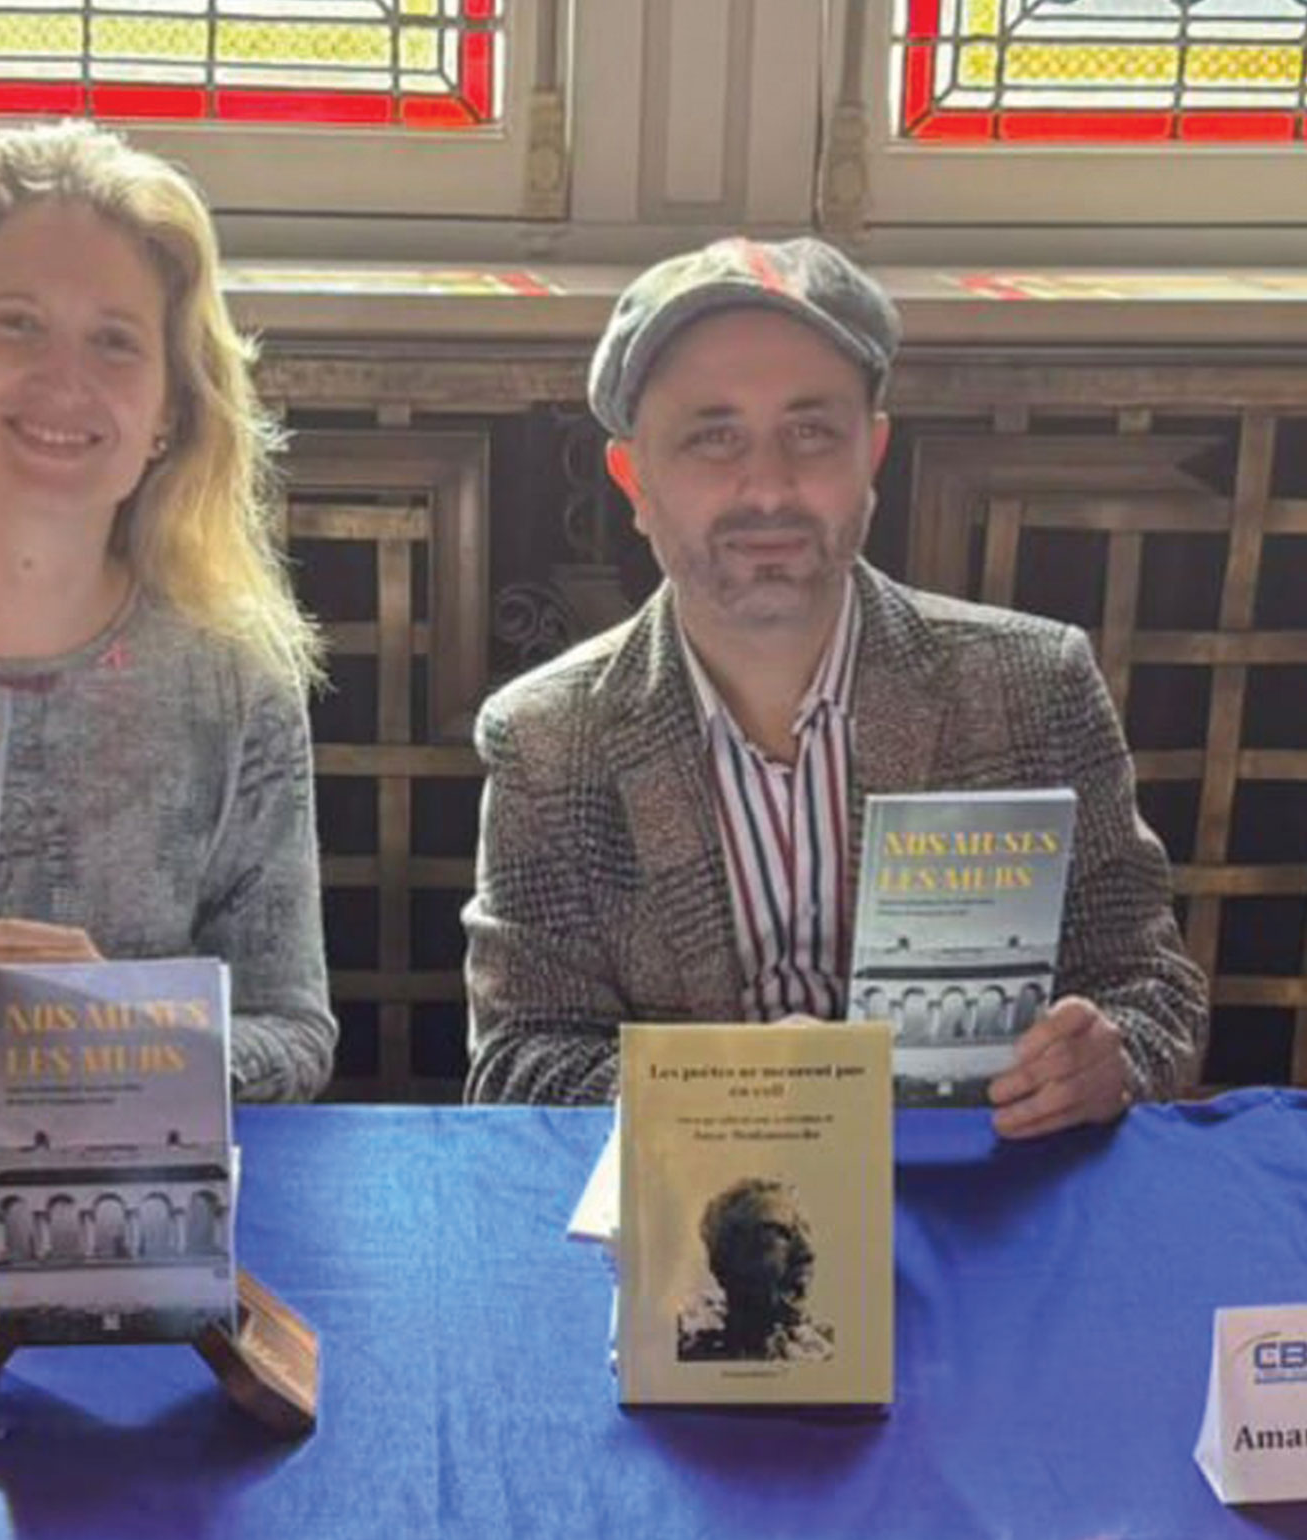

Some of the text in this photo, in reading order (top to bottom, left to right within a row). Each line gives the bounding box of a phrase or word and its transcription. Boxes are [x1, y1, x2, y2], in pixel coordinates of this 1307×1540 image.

[884, 830, 1061, 856] NOS MUSES
[876, 865, 1036, 891] LES MURS
[5, 998, 213, 1034] NOS MUSES
[5, 1044, 187, 1077] LES MURS
[1233, 1424, 1307, 1451] Ama
